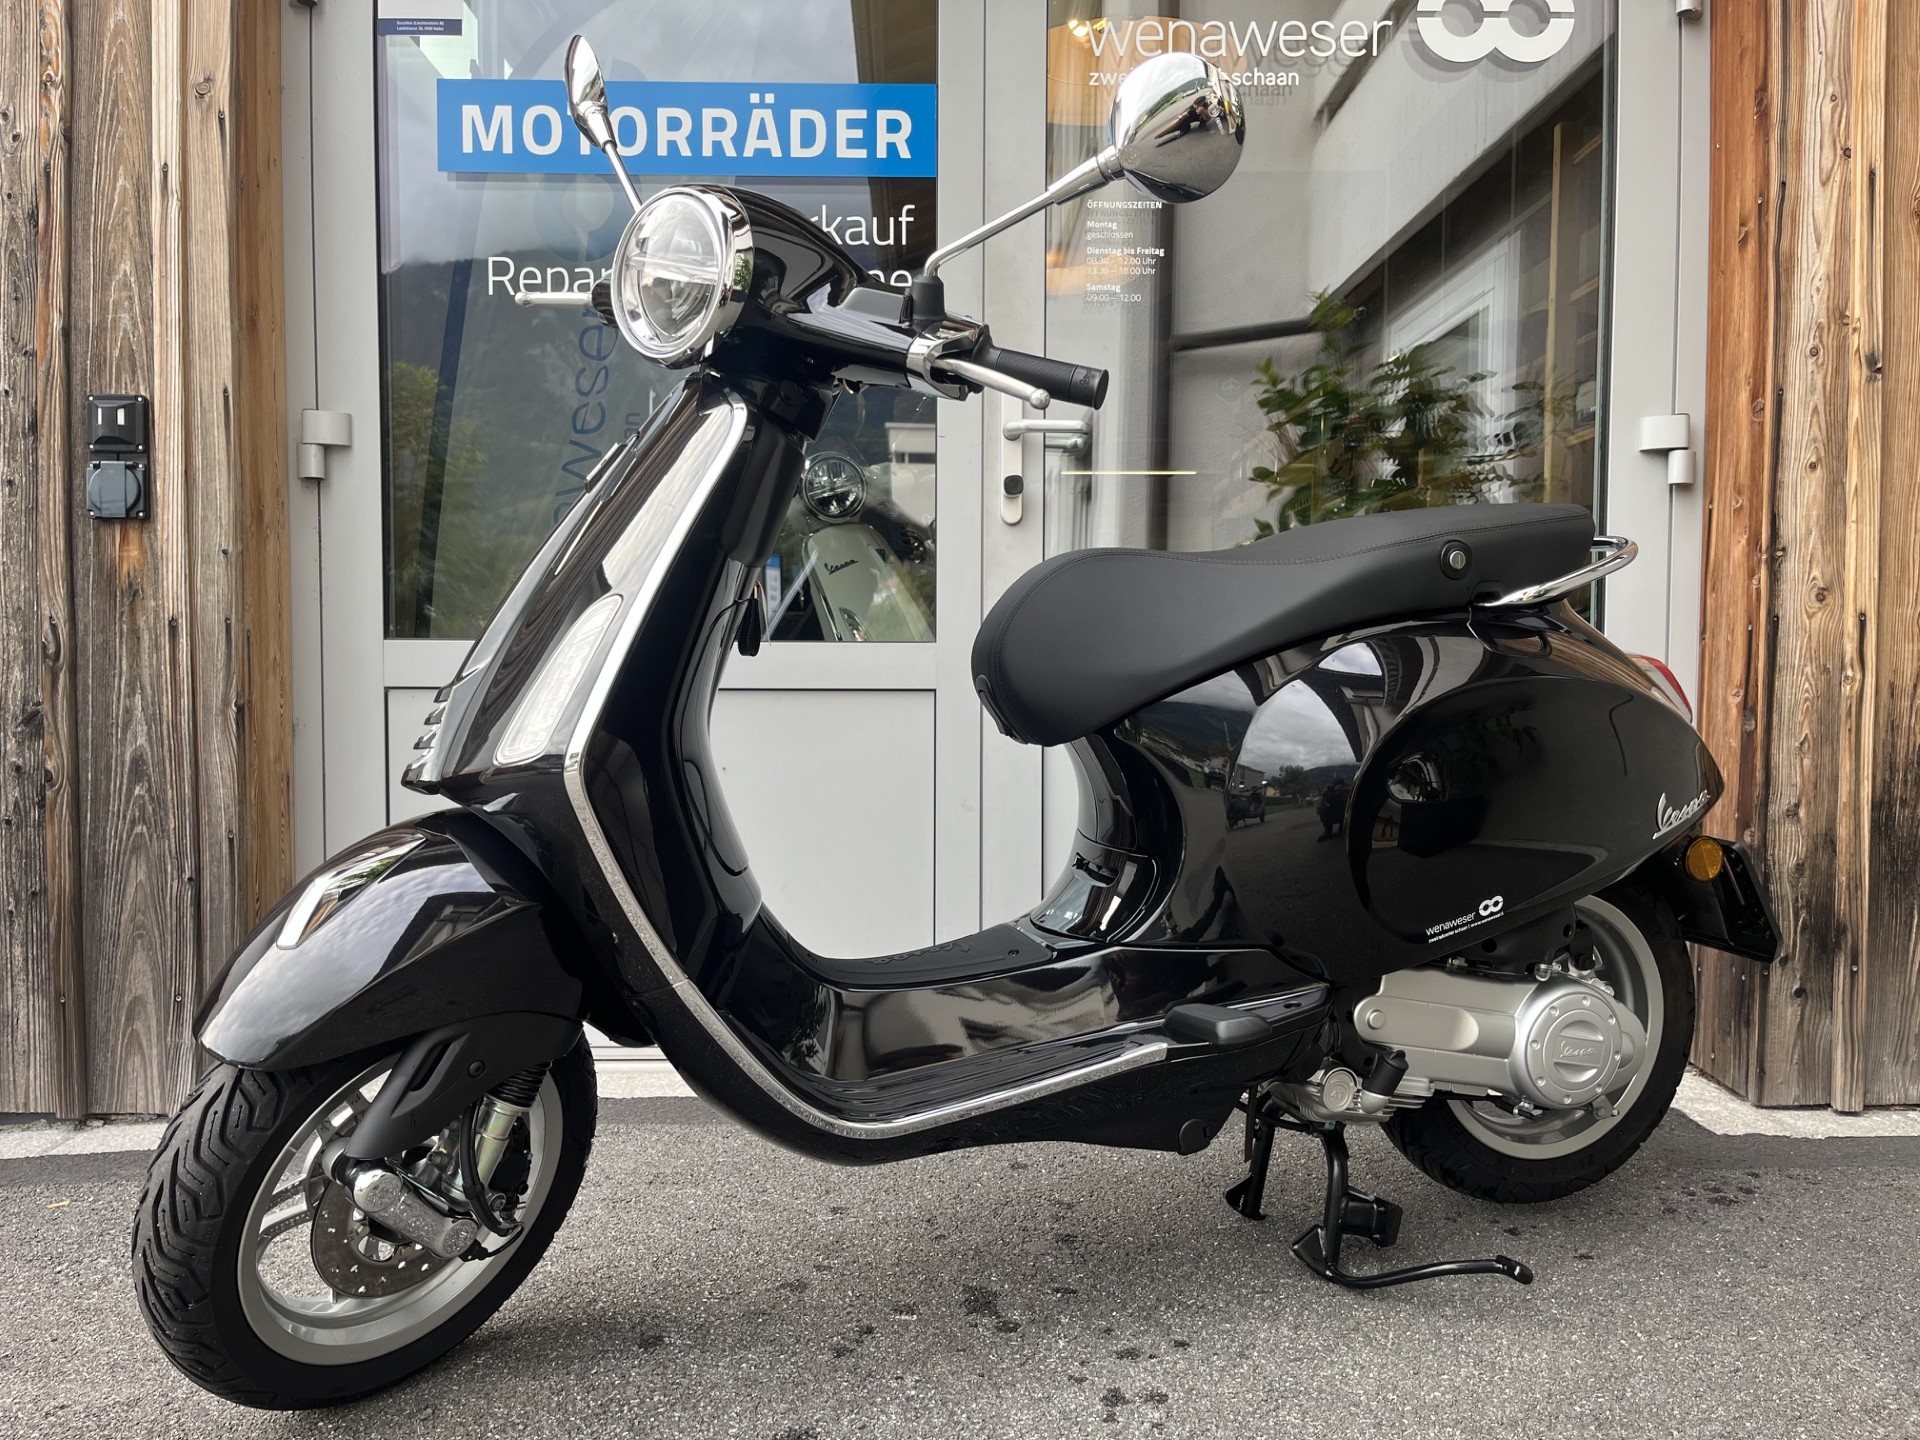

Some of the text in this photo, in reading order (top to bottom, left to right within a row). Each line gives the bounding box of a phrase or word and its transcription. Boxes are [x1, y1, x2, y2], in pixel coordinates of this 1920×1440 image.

[1089, 18, 1393, 58] wenaweser
[1234, 68, 1299, 86] schaan
[1087, 199, 1162, 209] ÖFFNUNGSZEITEN
[810, 203, 916, 246] kauf
[1087, 221, 1118, 230] Montag
[1087, 231, 1134, 241] geschlossen
[1087, 247, 1165, 257] Dienstag bis Freitag
[1119, 257, 1141, 265] 12.00
[1142, 257, 1157, 265] Uhr
[1119, 267, 1141, 275] 18.00
[1142, 267, 1157, 275] Uhr
[1087, 283, 1121, 293] Samstag
[1119, 294, 1142, 302] 12.00
[1652, 789, 1711, 840] Vespa
[1425, 911, 1476, 935] wenaweser
[1560, 1040, 1599, 1058] Vespa
